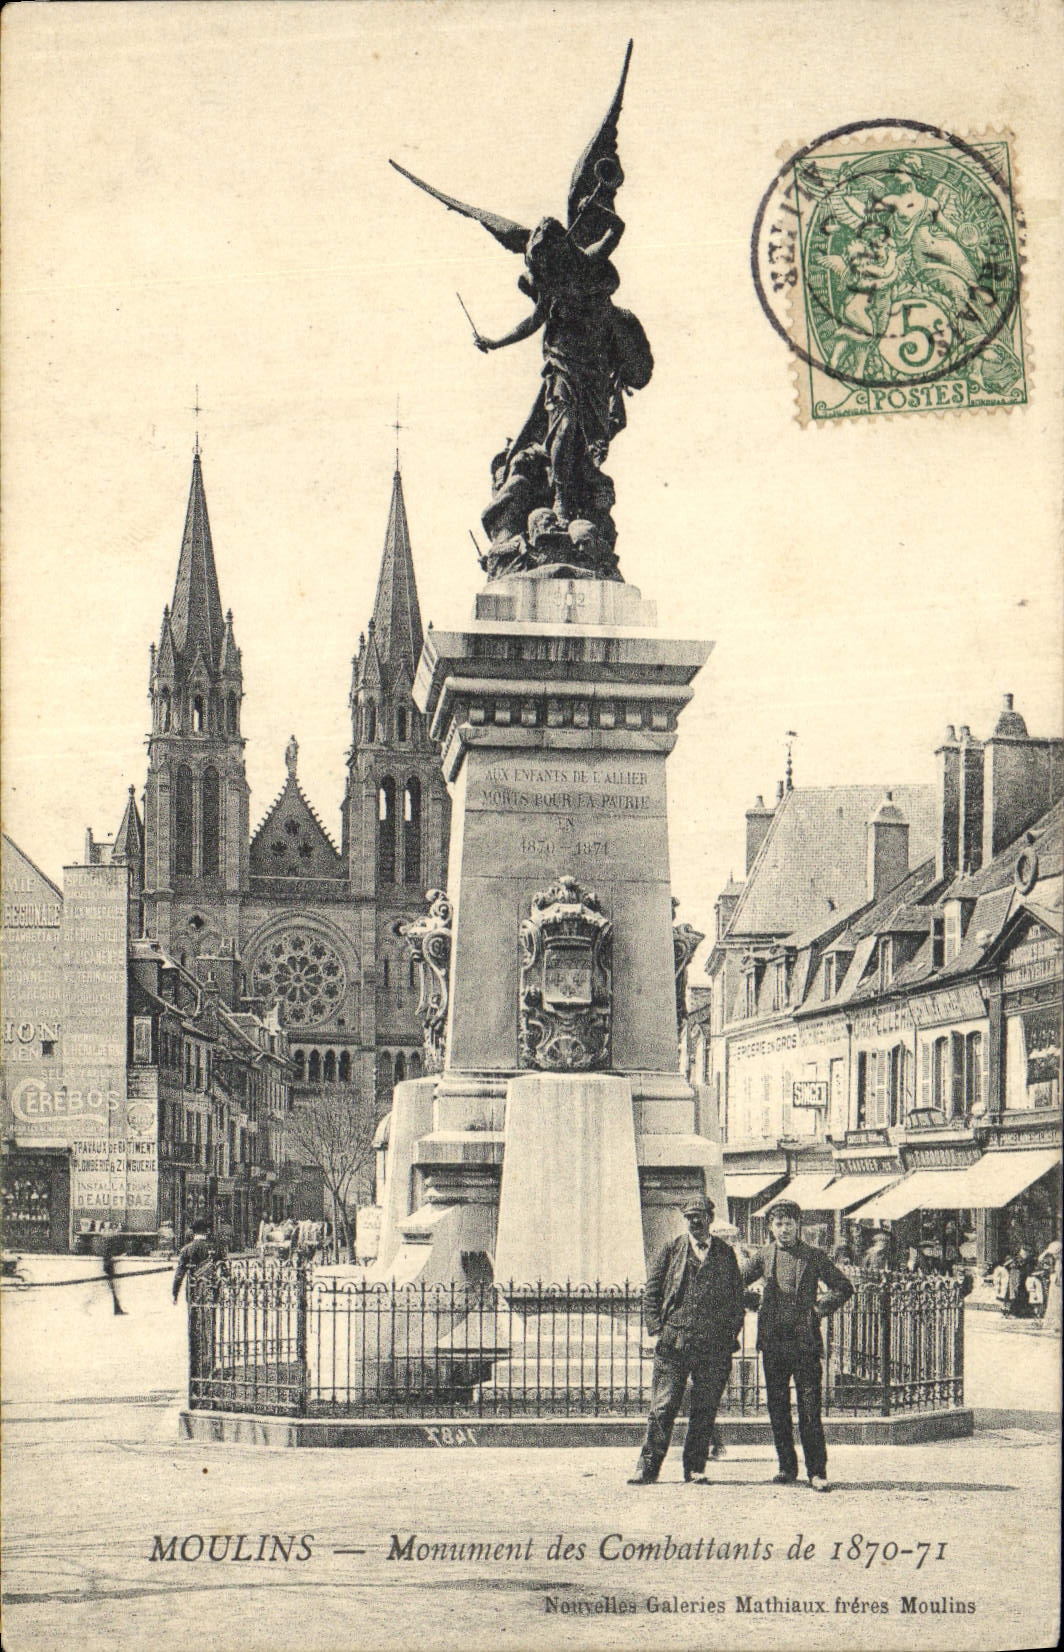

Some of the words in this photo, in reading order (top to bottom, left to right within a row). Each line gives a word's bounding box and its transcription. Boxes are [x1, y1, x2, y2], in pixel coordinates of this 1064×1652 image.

[871, 383, 964, 411] POSTES
[486, 768, 509, 781] AUX
[514, 769, 567, 783] ENFANTS
[572, 770, 588, 783] DE
[482, 791, 528, 807] MORTS
[534, 792, 570, 807] POUR
[576, 794, 596, 808] LA
[601, 795, 650, 810] PATRIE
[73, 1141, 107, 1154] TRAVAUX
